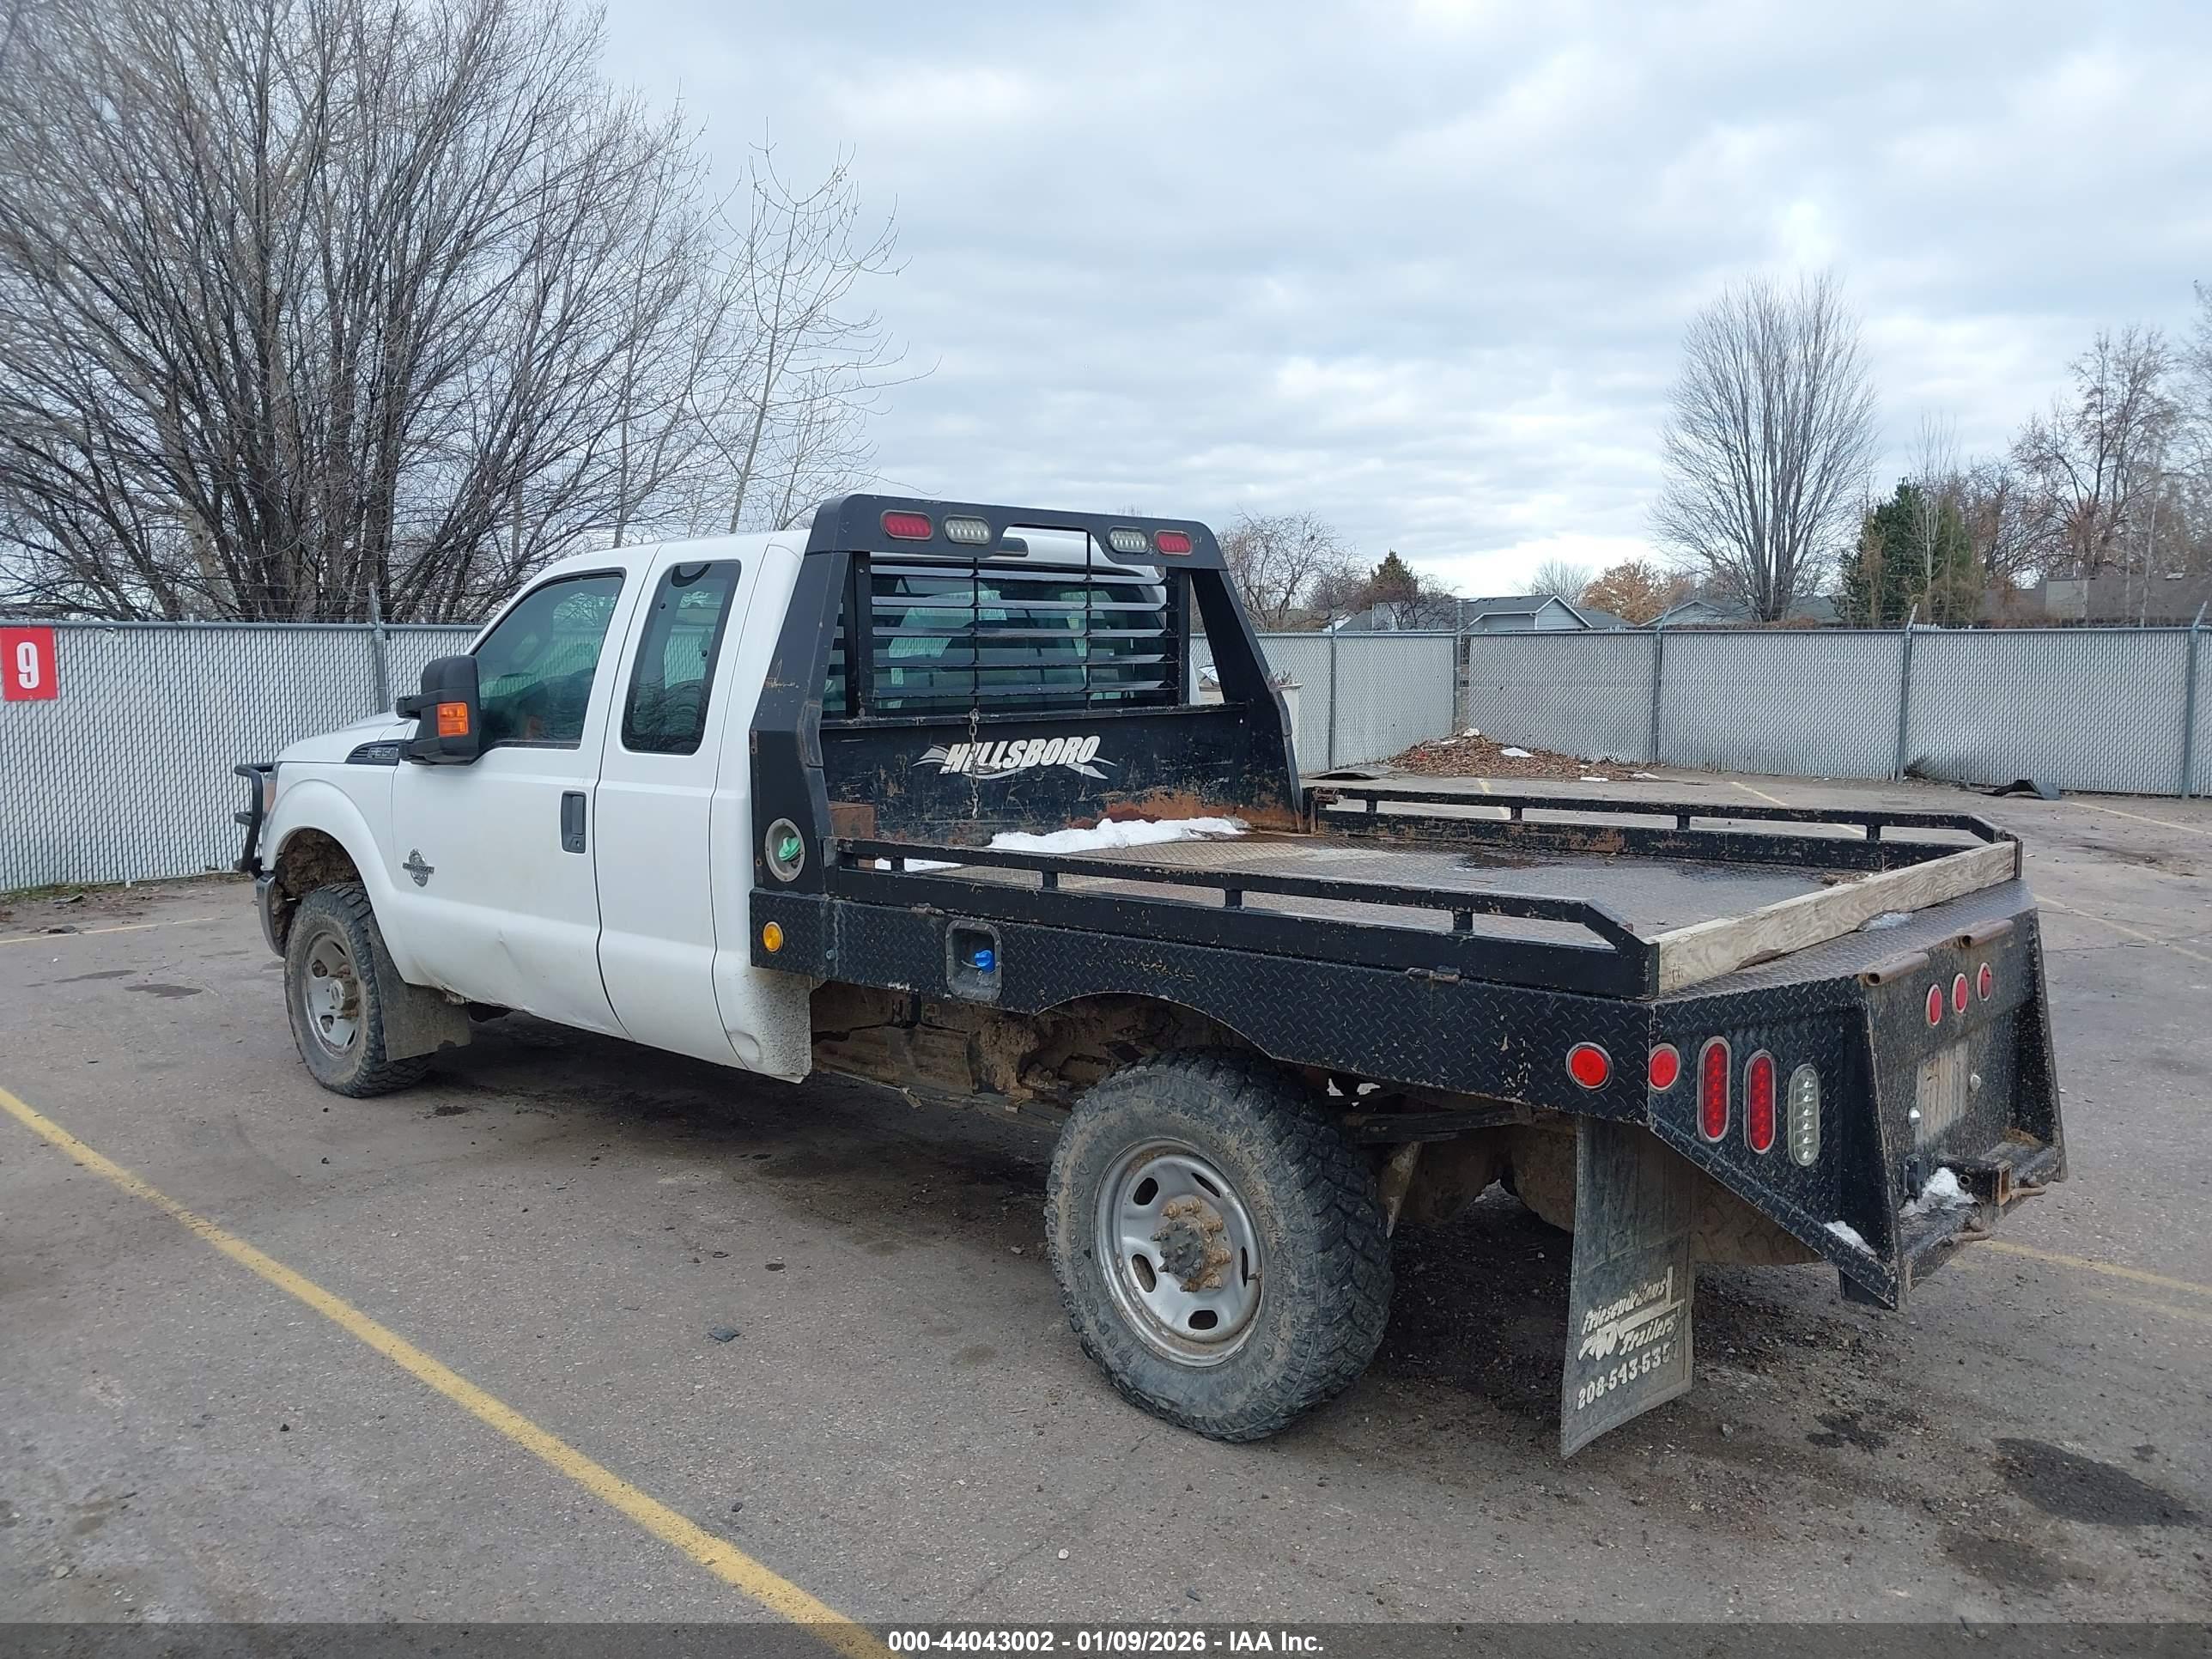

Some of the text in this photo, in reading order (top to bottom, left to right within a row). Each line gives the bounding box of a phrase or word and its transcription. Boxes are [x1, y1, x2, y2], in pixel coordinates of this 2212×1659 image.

[16, 641, 40, 690] 9
[939, 735, 1101, 775] HILLSBORO
[1619, 1314, 1675, 1356] Trailers
[1577, 1338, 1678, 1410] 208-543-535
